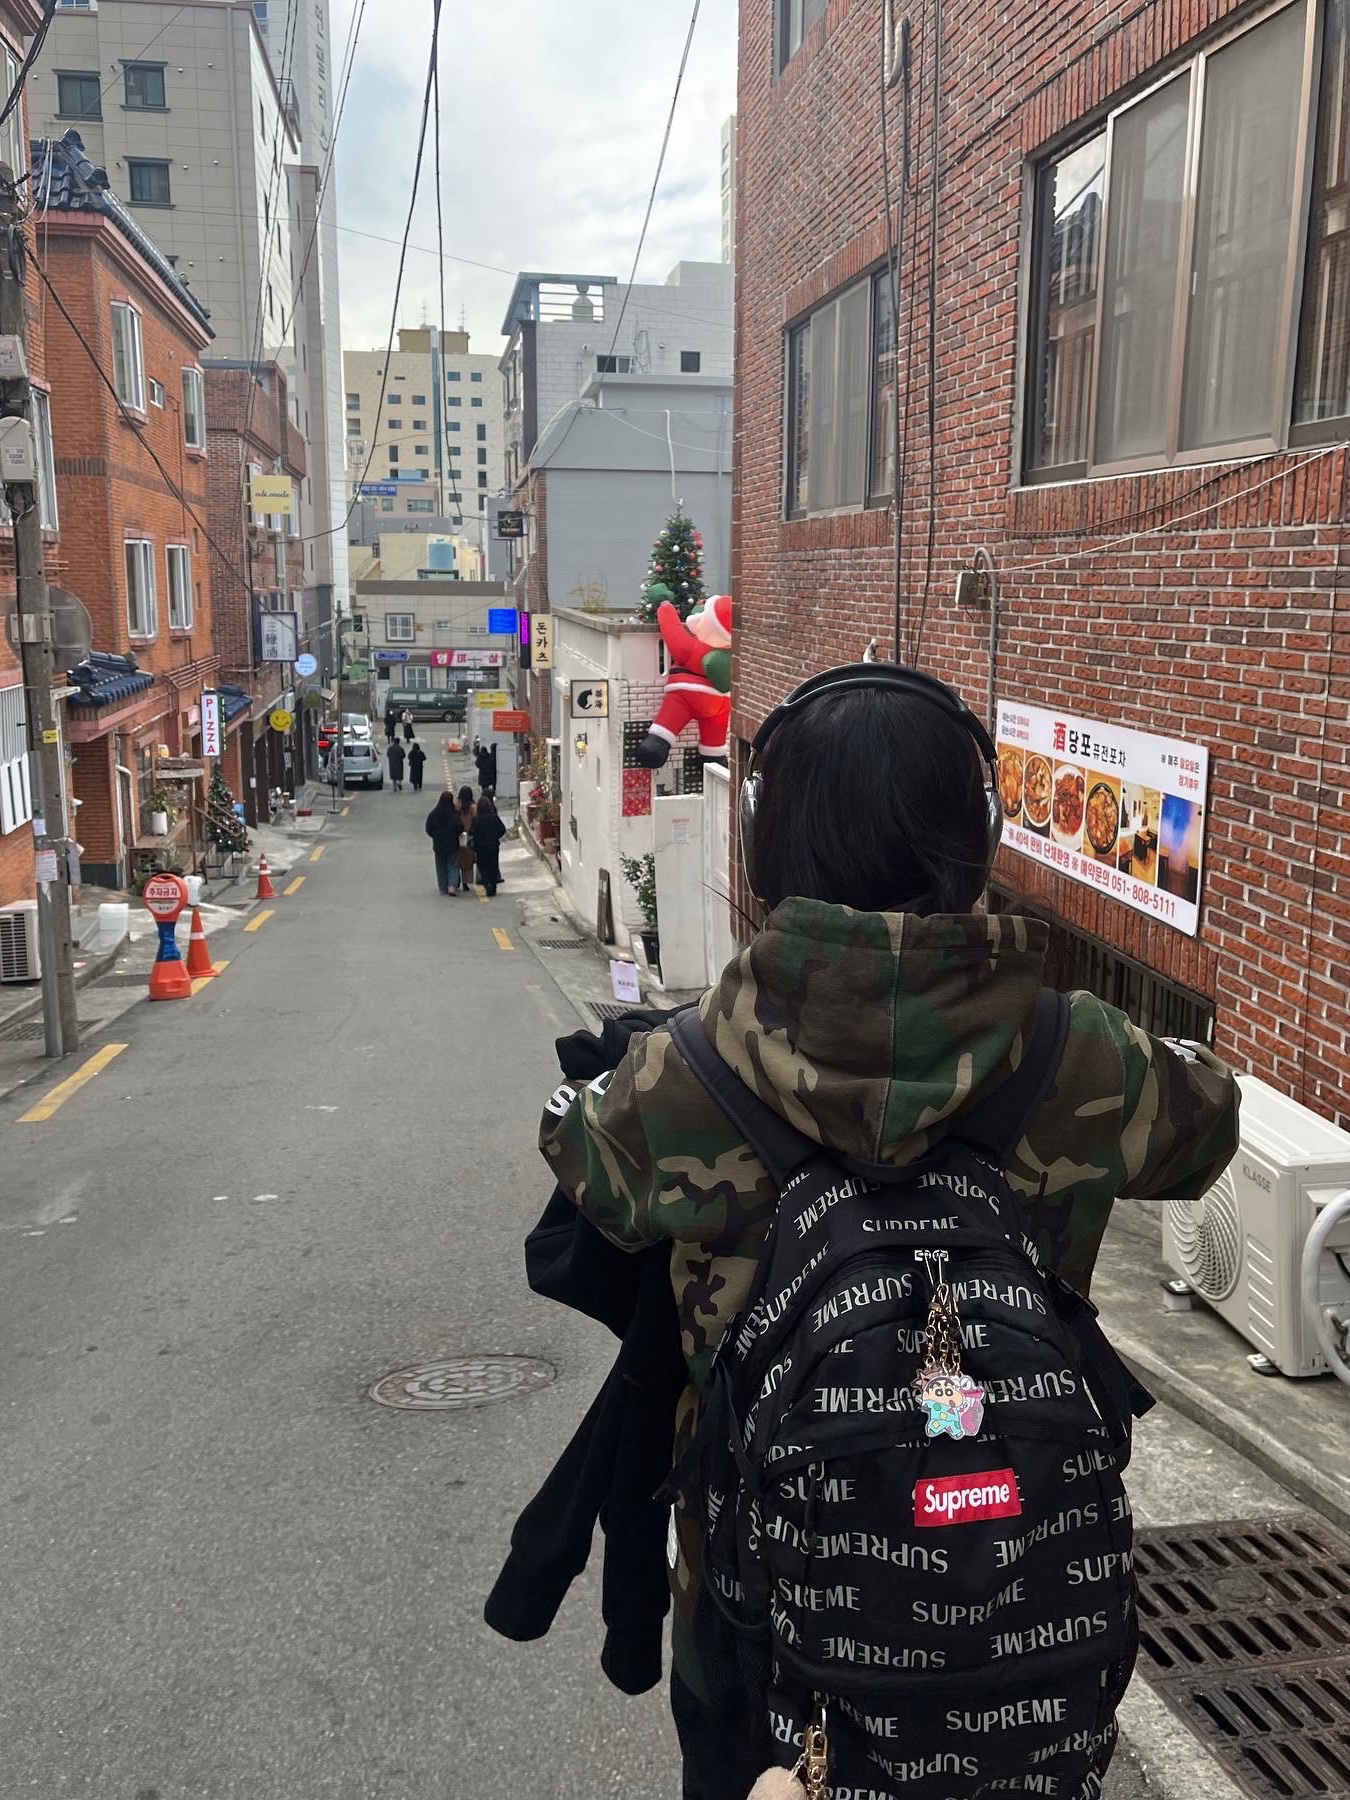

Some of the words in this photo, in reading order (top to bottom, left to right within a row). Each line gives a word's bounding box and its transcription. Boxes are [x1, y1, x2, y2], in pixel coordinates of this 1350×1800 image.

[536, 622, 549, 662] 돈카츠
[205, 698, 216, 753] PIZZA
[1093, 743, 1126, 768] 퓨전포차
[1043, 842, 1070, 868] 단체환영
[1080, 860, 1110, 888] 예약문의
[1132, 884, 1175, 918] 808-5111
[812, 1273, 913, 1334] SUPREME
[923, 1483, 1011, 1520] Supreme
[814, 1532, 949, 1574] SUPREME
[993, 1502, 1099, 1569] SUPREME
[912, 1577, 1026, 1626] SUPREME
[821, 1636, 947, 1669] SUPREME
[989, 1610, 1108, 1660] SUPREME
[945, 1698, 1068, 1734] SUPREME
